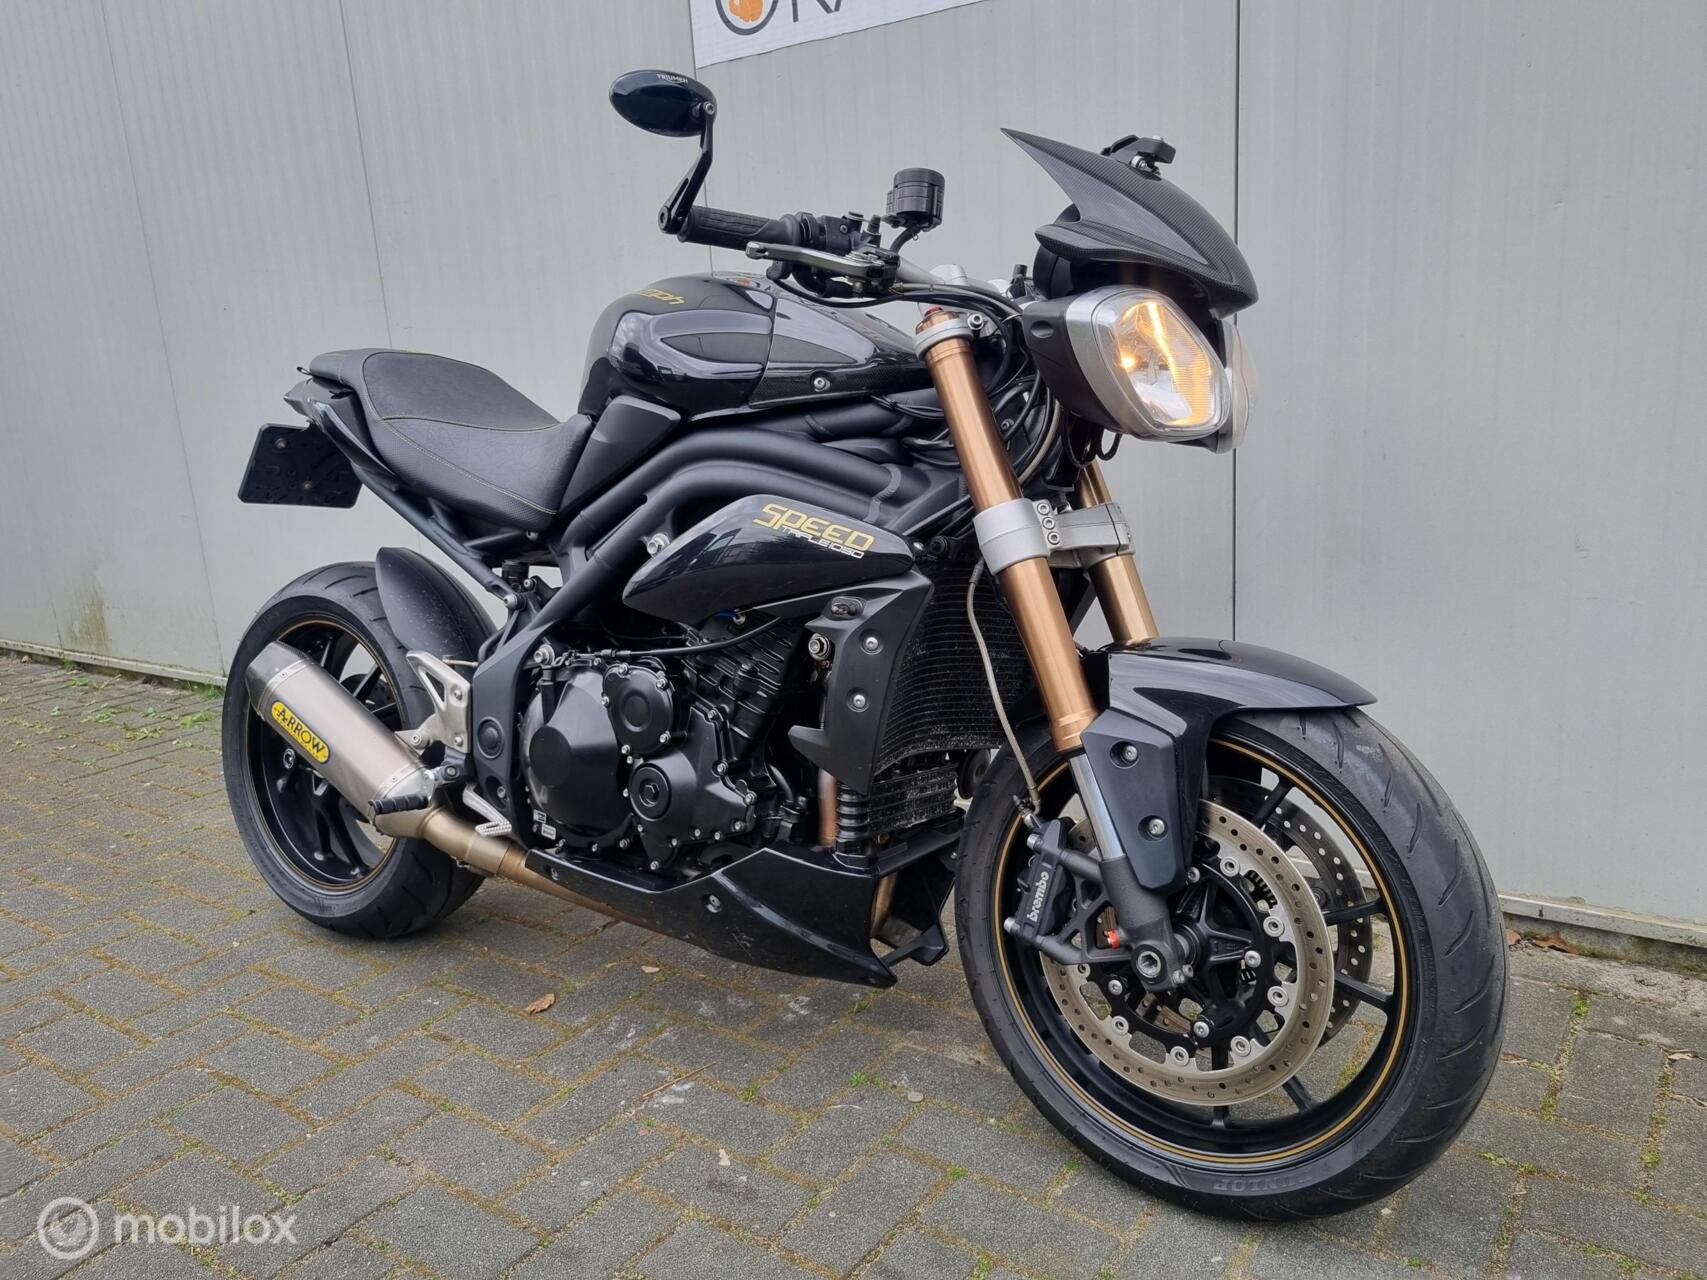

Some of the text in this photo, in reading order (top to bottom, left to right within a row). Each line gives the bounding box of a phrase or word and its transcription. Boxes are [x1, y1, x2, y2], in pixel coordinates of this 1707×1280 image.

[656, 73, 689, 85] TRIUMPH
[752, 503, 875, 551] SPEED
[277, 707, 326, 754] ARROW
[1027, 871, 1049, 922] brembo
